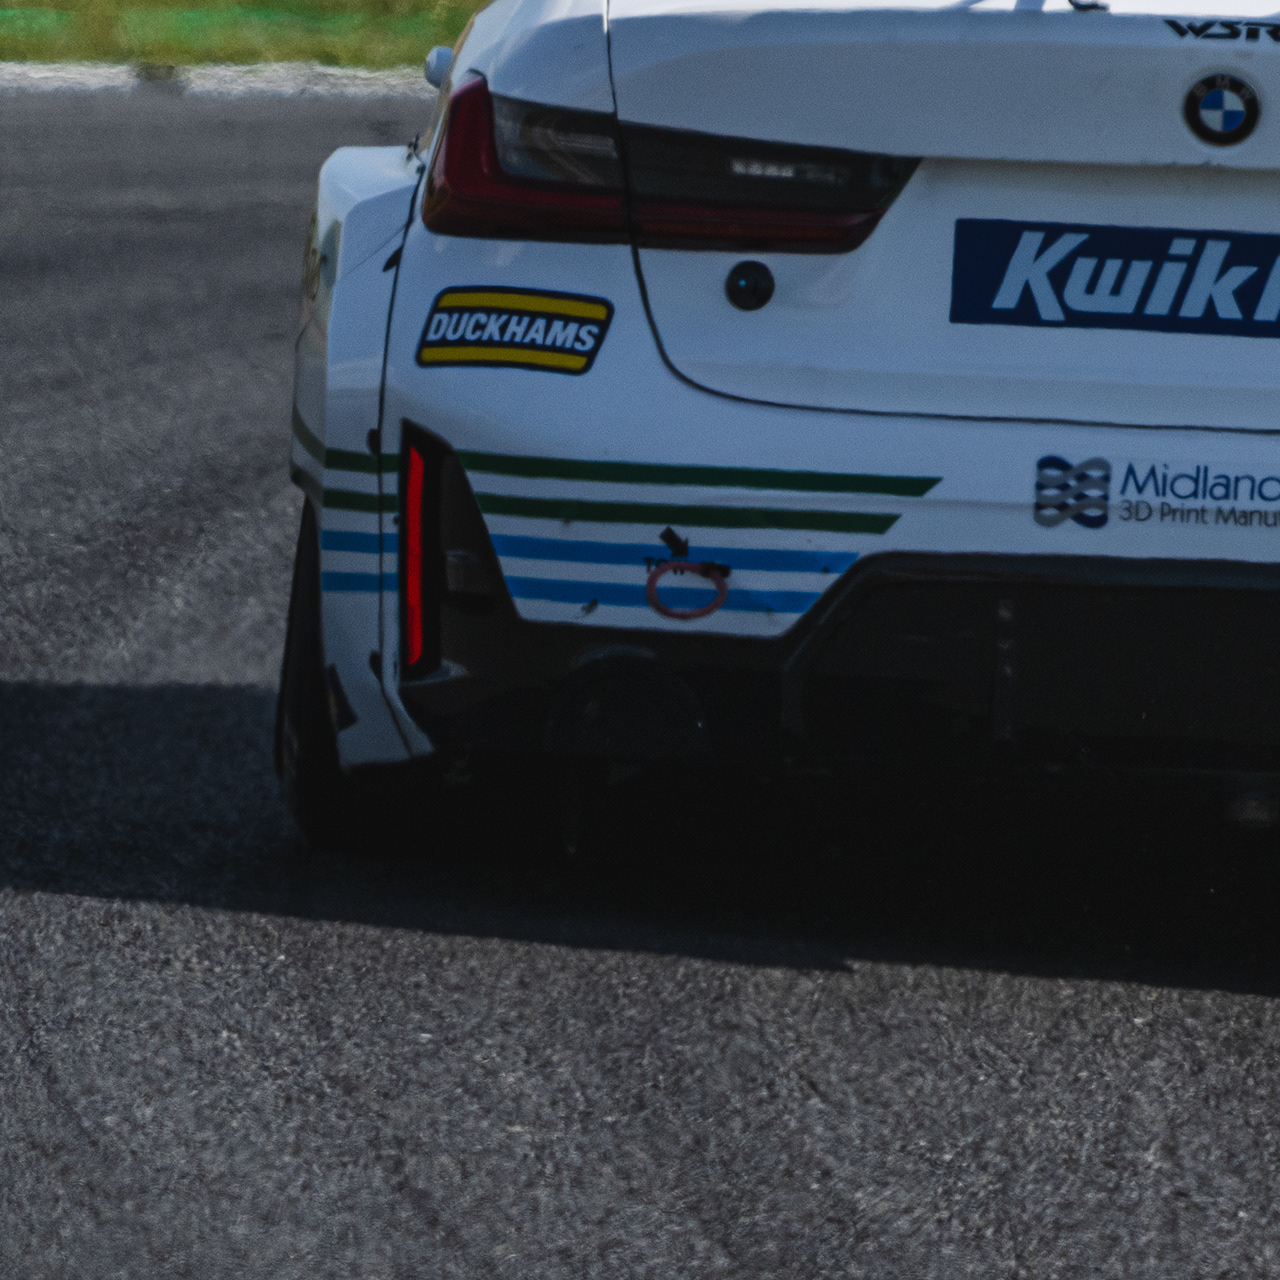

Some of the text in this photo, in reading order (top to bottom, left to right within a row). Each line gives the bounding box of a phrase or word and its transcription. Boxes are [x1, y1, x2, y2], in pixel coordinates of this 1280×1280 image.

[426, 312, 599, 352] DUCKHAMS
[1119, 500, 1150, 522] 3D
[1160, 501, 1208, 525] Print
